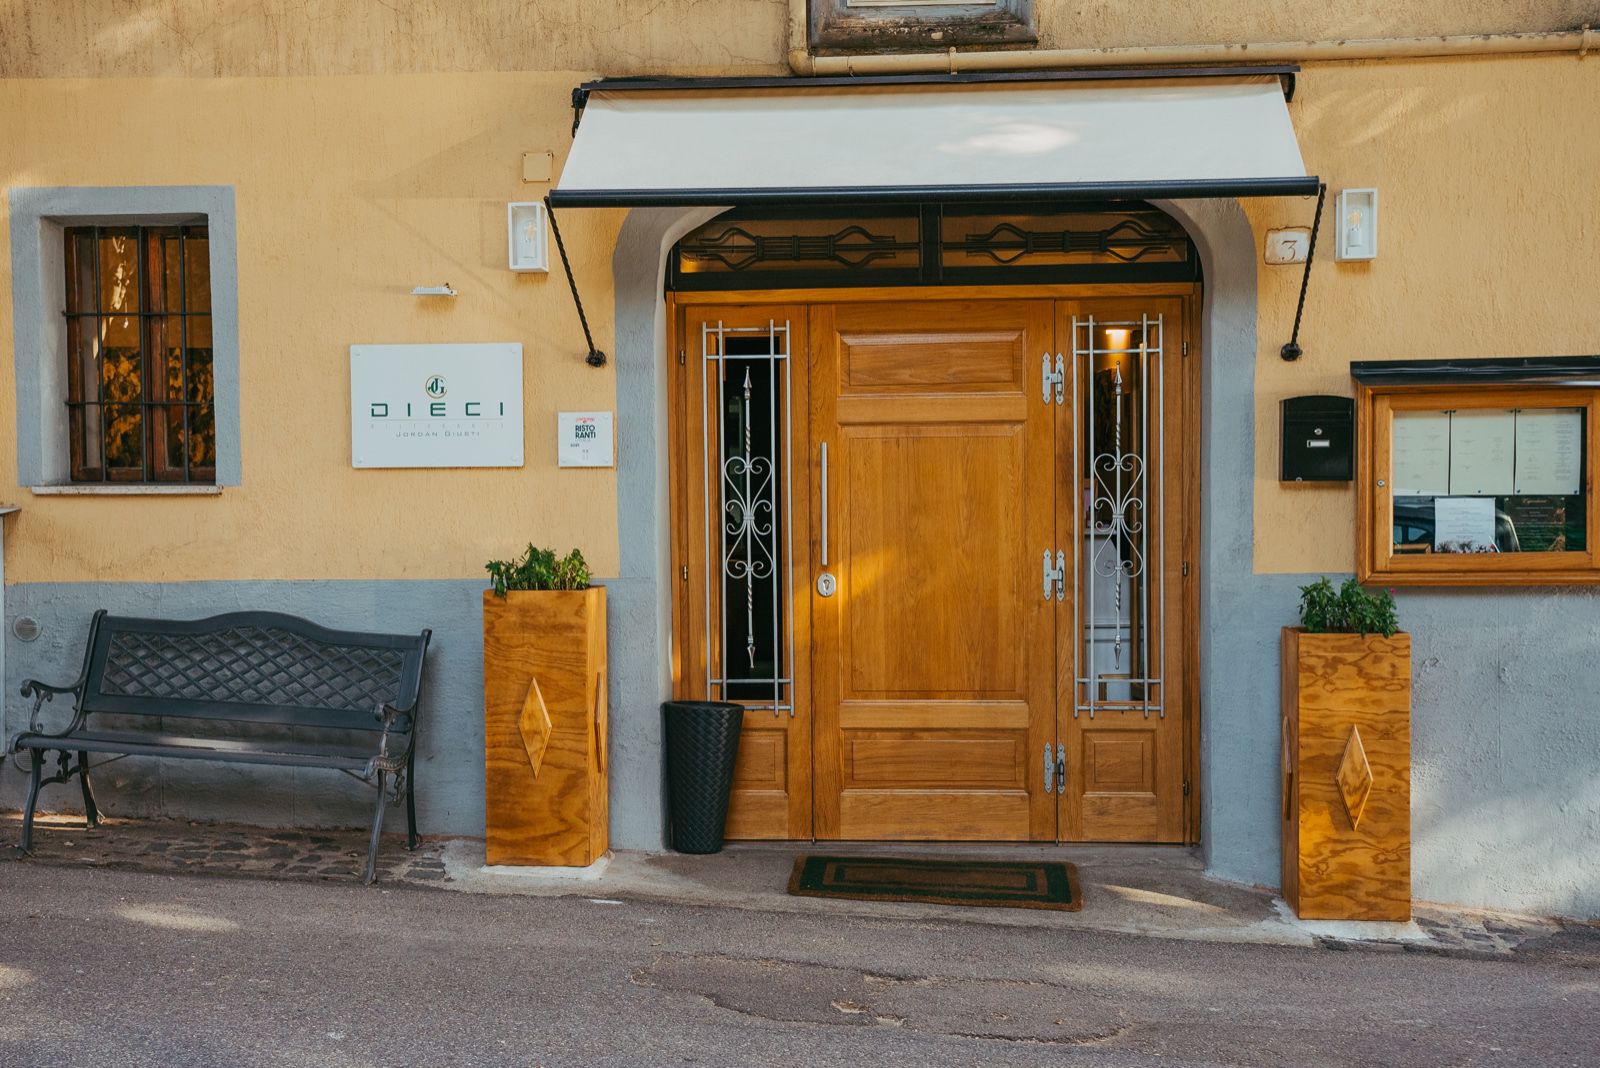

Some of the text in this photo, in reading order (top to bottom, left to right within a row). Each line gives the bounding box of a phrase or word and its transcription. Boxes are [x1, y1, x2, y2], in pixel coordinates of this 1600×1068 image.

[1281, 240, 1298, 261] 3
[371, 402, 503, 417] DIECI
[575, 424, 596, 432] RISTO
[575, 431, 596, 439] RANTI
